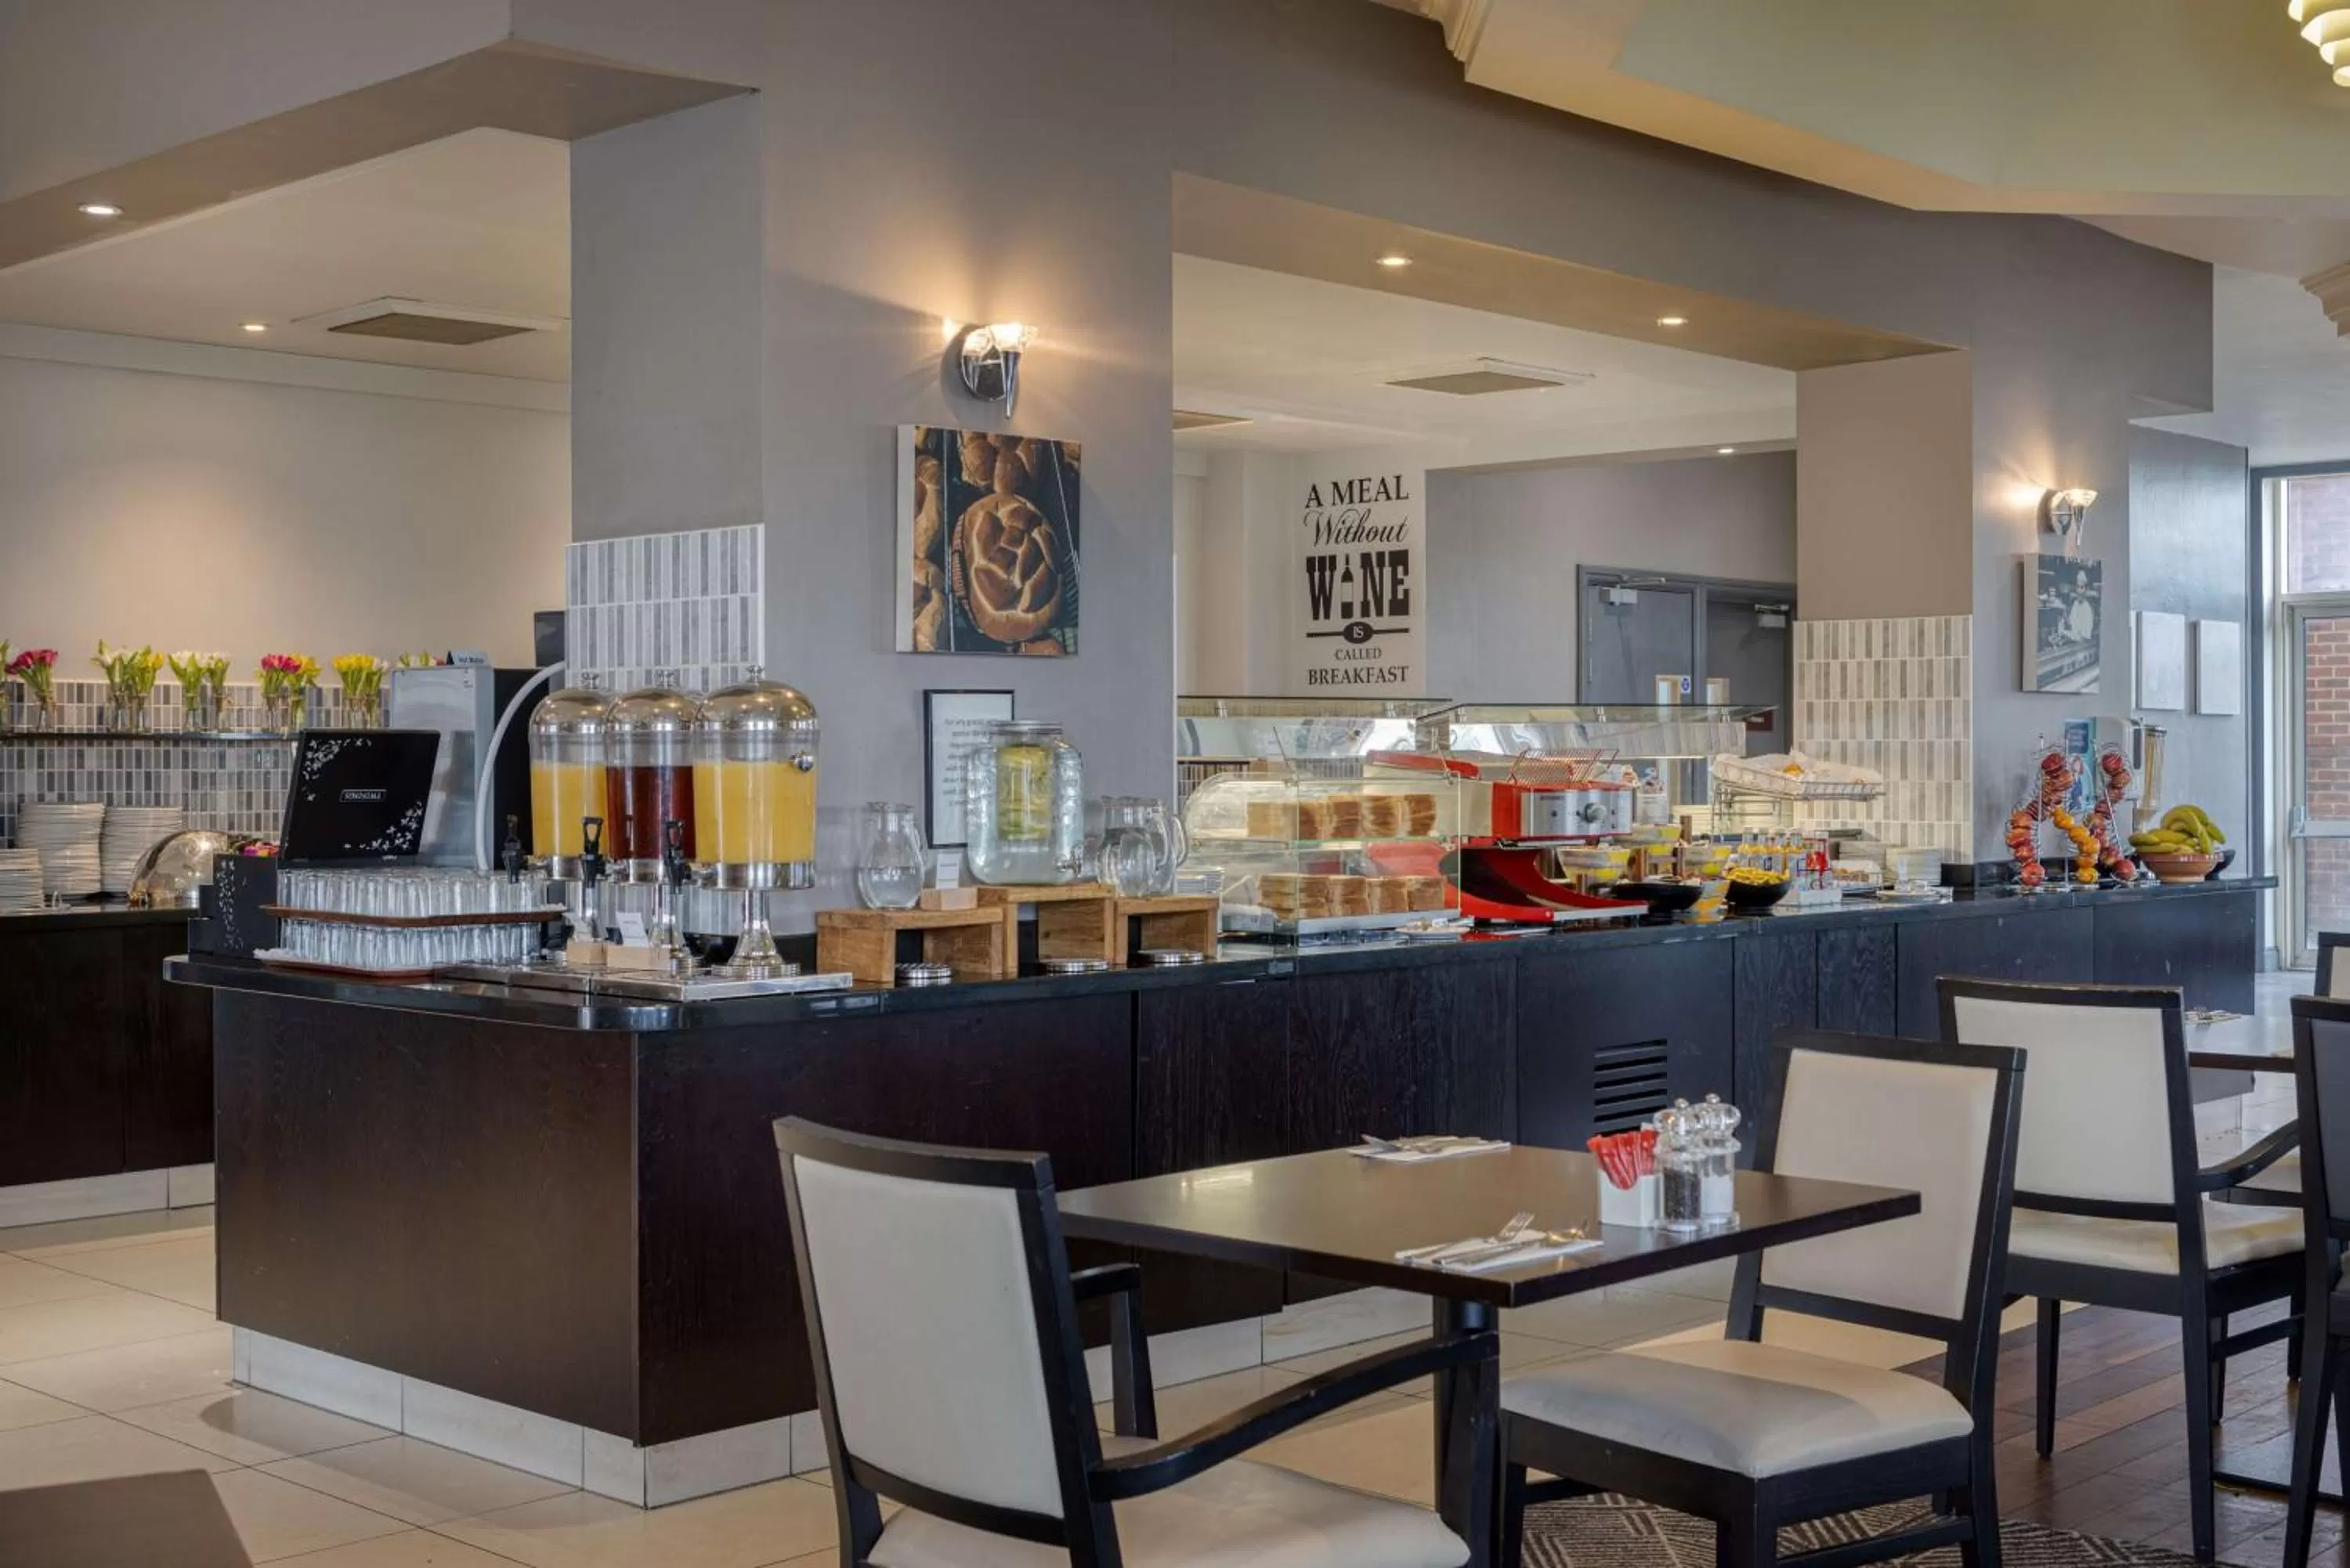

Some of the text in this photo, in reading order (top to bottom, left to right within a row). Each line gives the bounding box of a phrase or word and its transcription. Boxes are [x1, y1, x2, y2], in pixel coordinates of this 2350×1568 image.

[1304, 474, 1409, 508] A MEAL
[1303, 508, 1409, 547] Without
[1353, 625, 1365, 638] IS
[1335, 648, 1383, 660] CALLED
[1308, 666, 1409, 685] BREAKFAST
